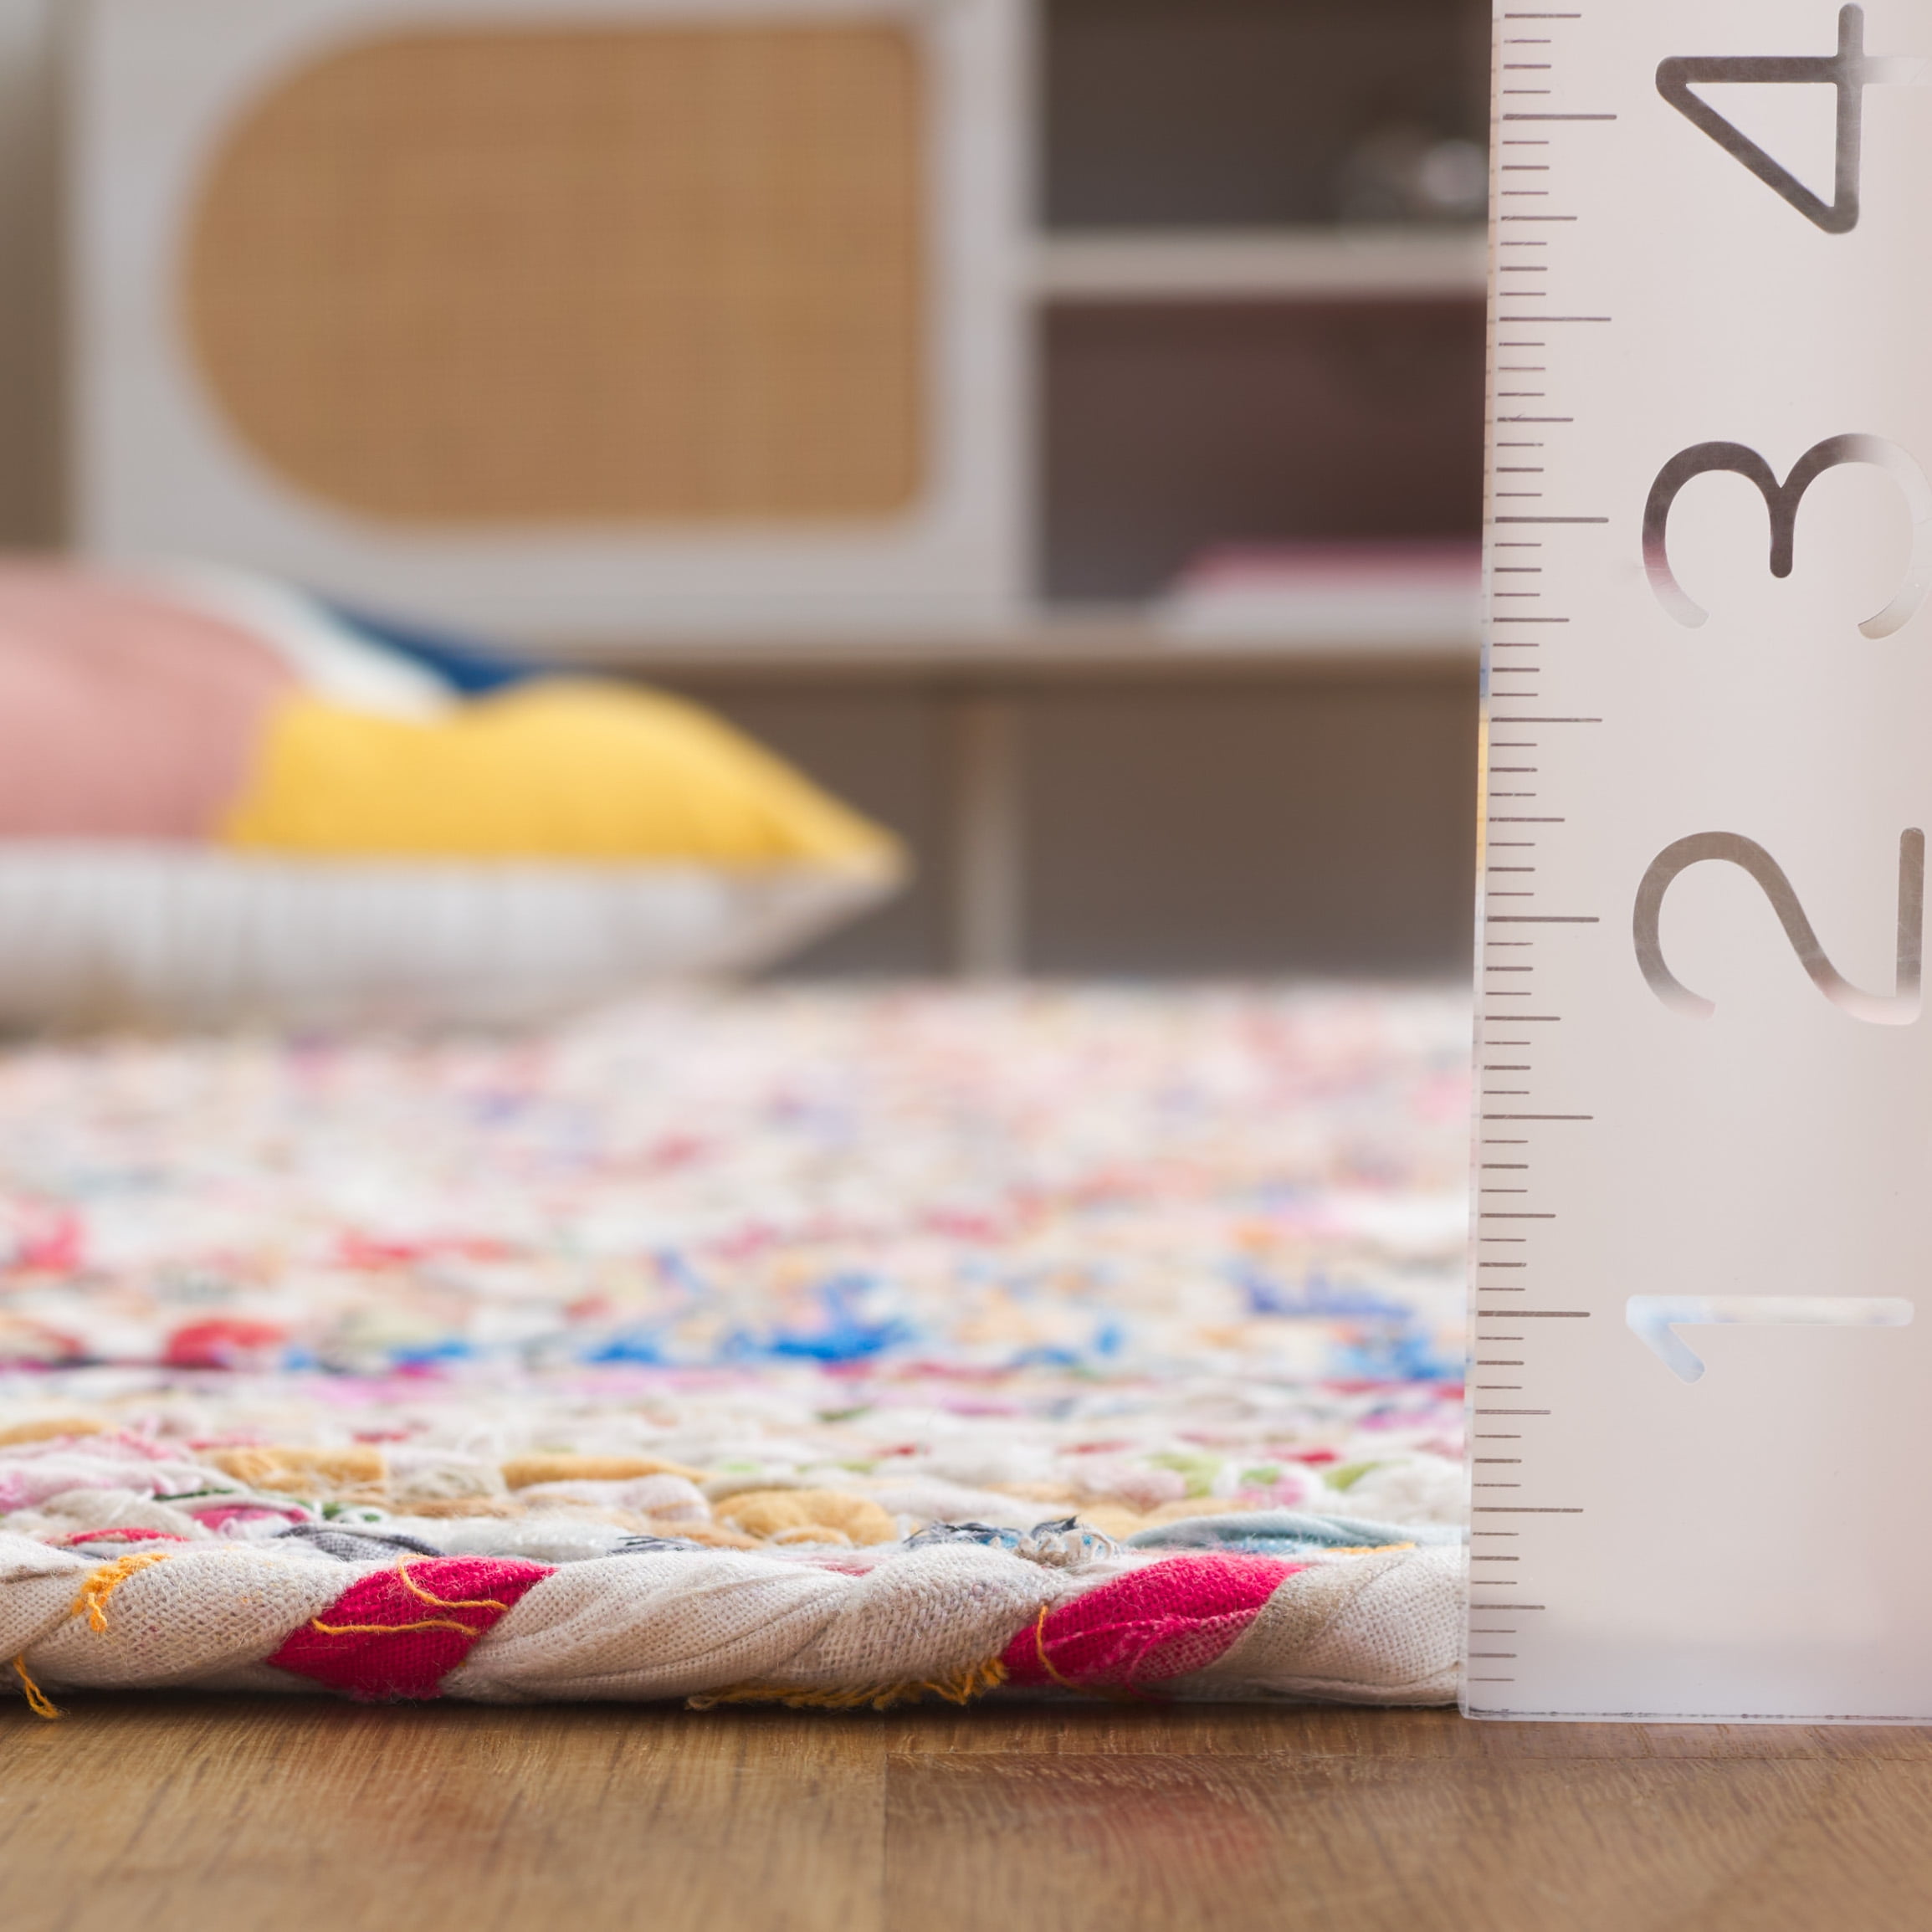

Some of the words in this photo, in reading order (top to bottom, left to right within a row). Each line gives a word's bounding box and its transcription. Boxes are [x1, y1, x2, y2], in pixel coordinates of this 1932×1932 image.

[1655, 3, 1932, 233] 4
[1642, 433, 1932, 639] 3
[1632, 827, 1925, 1026] 2
[1626, 1294, 1914, 1383] 1
